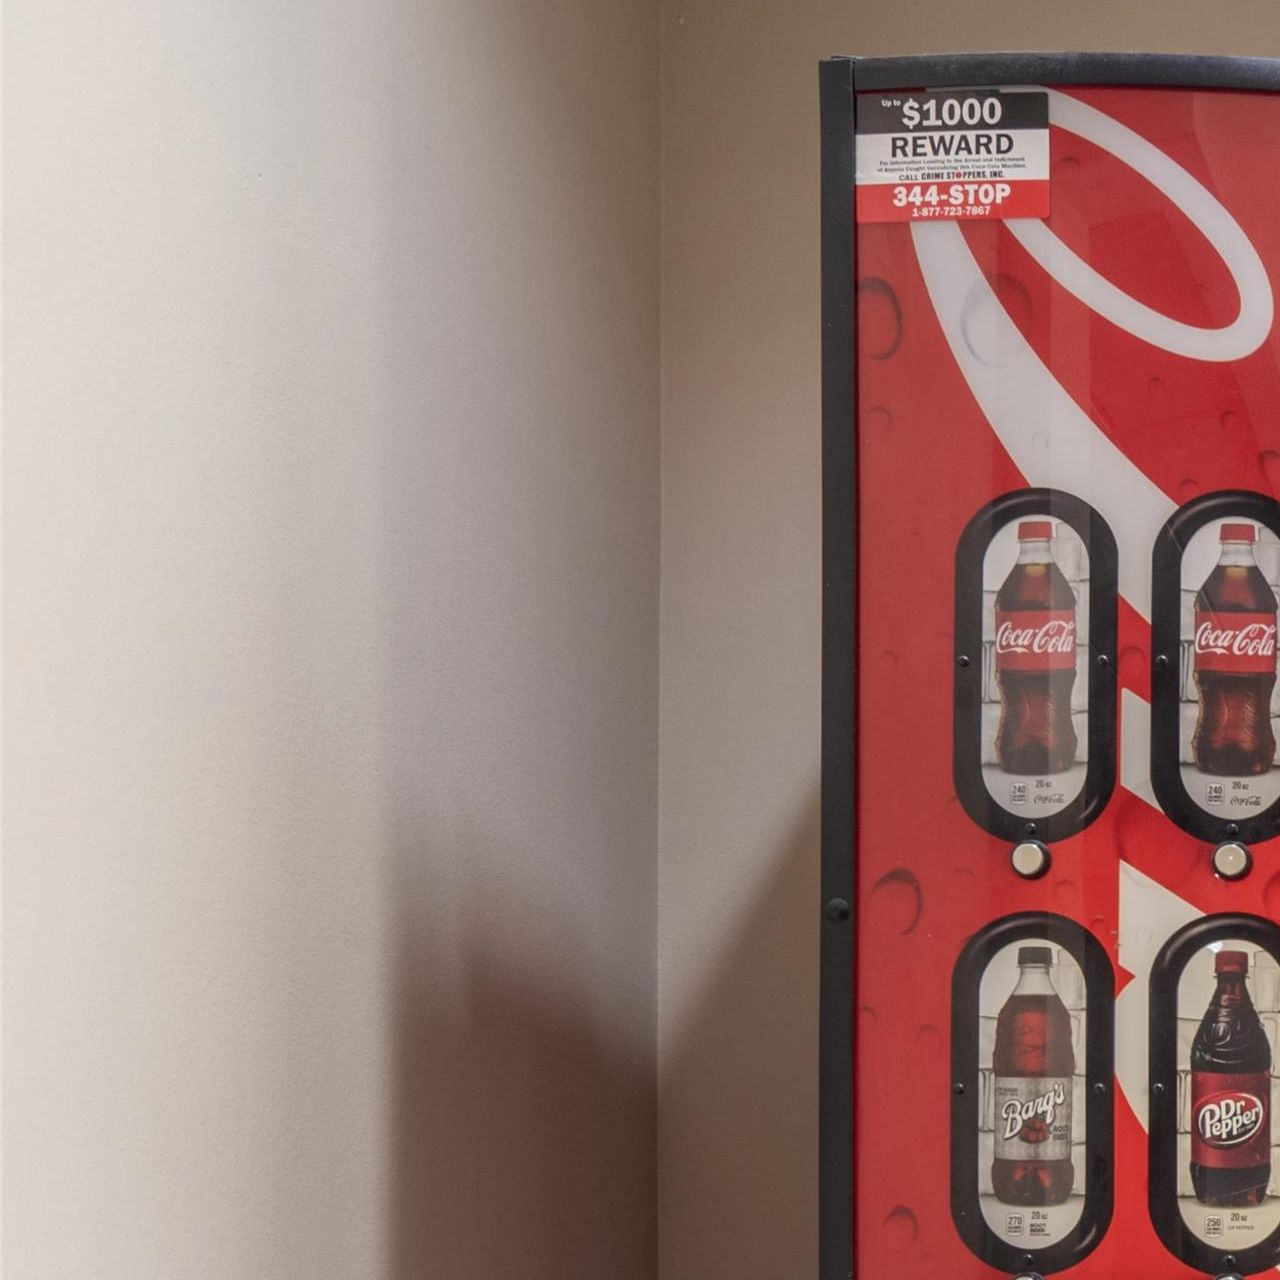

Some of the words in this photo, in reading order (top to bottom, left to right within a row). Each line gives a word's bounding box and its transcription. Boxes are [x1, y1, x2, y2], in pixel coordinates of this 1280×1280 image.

[882, 99, 891, 107] Up
[902, 97, 1002, 129] $1000
[891, 134, 1014, 158] REWARD
[921, 172, 944, 180] CRIME
[990, 170, 1005, 178] INC.
[893, 184, 1011, 207] 344-STOP
[996, 620, 1076, 654] Coca-Cola
[1195, 620, 1277, 656] Coca-Cola
[1012, 786, 1026, 794] 240
[1208, 786, 1222, 794] 240
[1232, 781, 1242, 790] 20
[1002, 1083, 1065, 1141] Barq's
[1220, 1099, 1245, 1120] Dr
[1198, 1104, 1259, 1139] Pepper
[1008, 1216, 1022, 1225] 270
[1206, 1218, 1221, 1227] 250
[1230, 1213, 1239, 1221] 20
